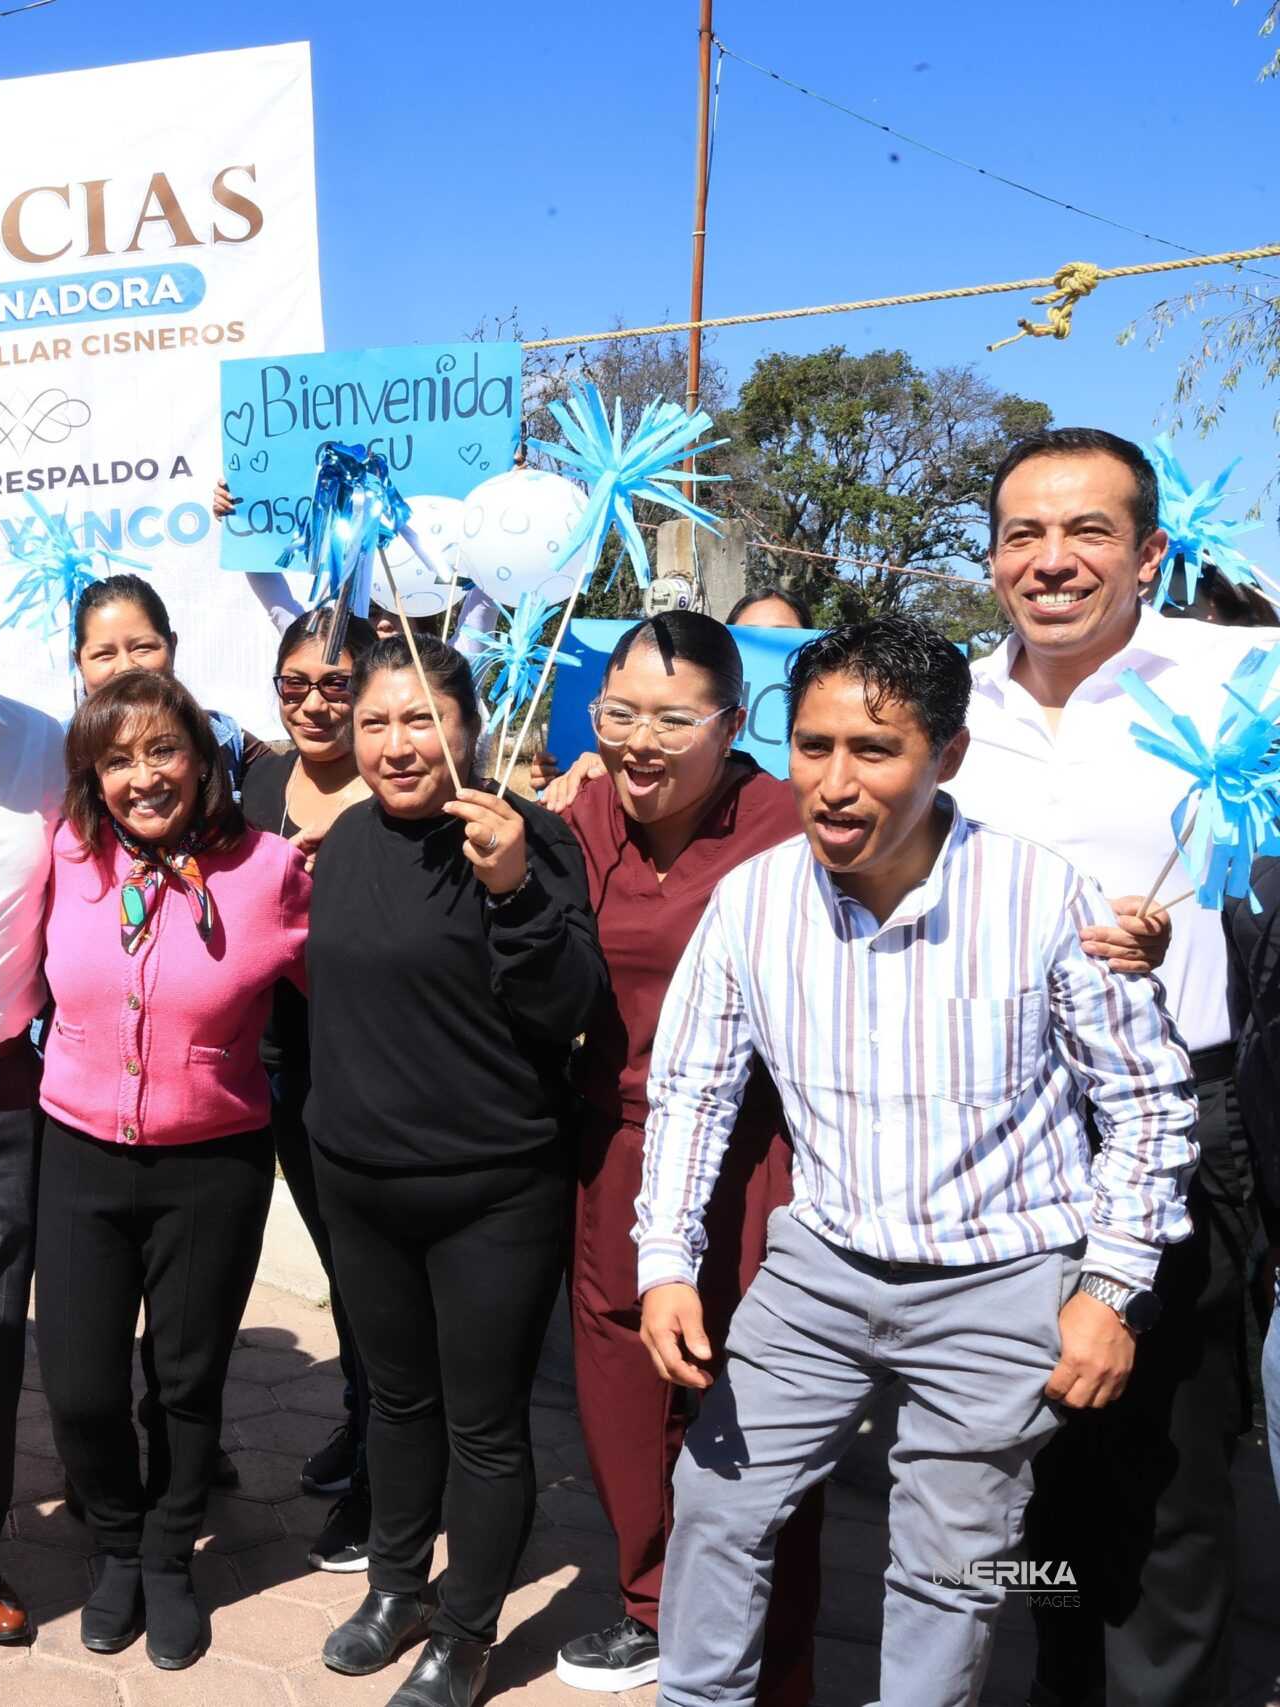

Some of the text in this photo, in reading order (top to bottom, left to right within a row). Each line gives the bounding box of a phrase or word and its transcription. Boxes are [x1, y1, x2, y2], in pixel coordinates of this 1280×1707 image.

[80, 319, 246, 357] CISNEROS
[260, 351, 513, 438] Bienvenida
[169, 455, 193, 480] A
